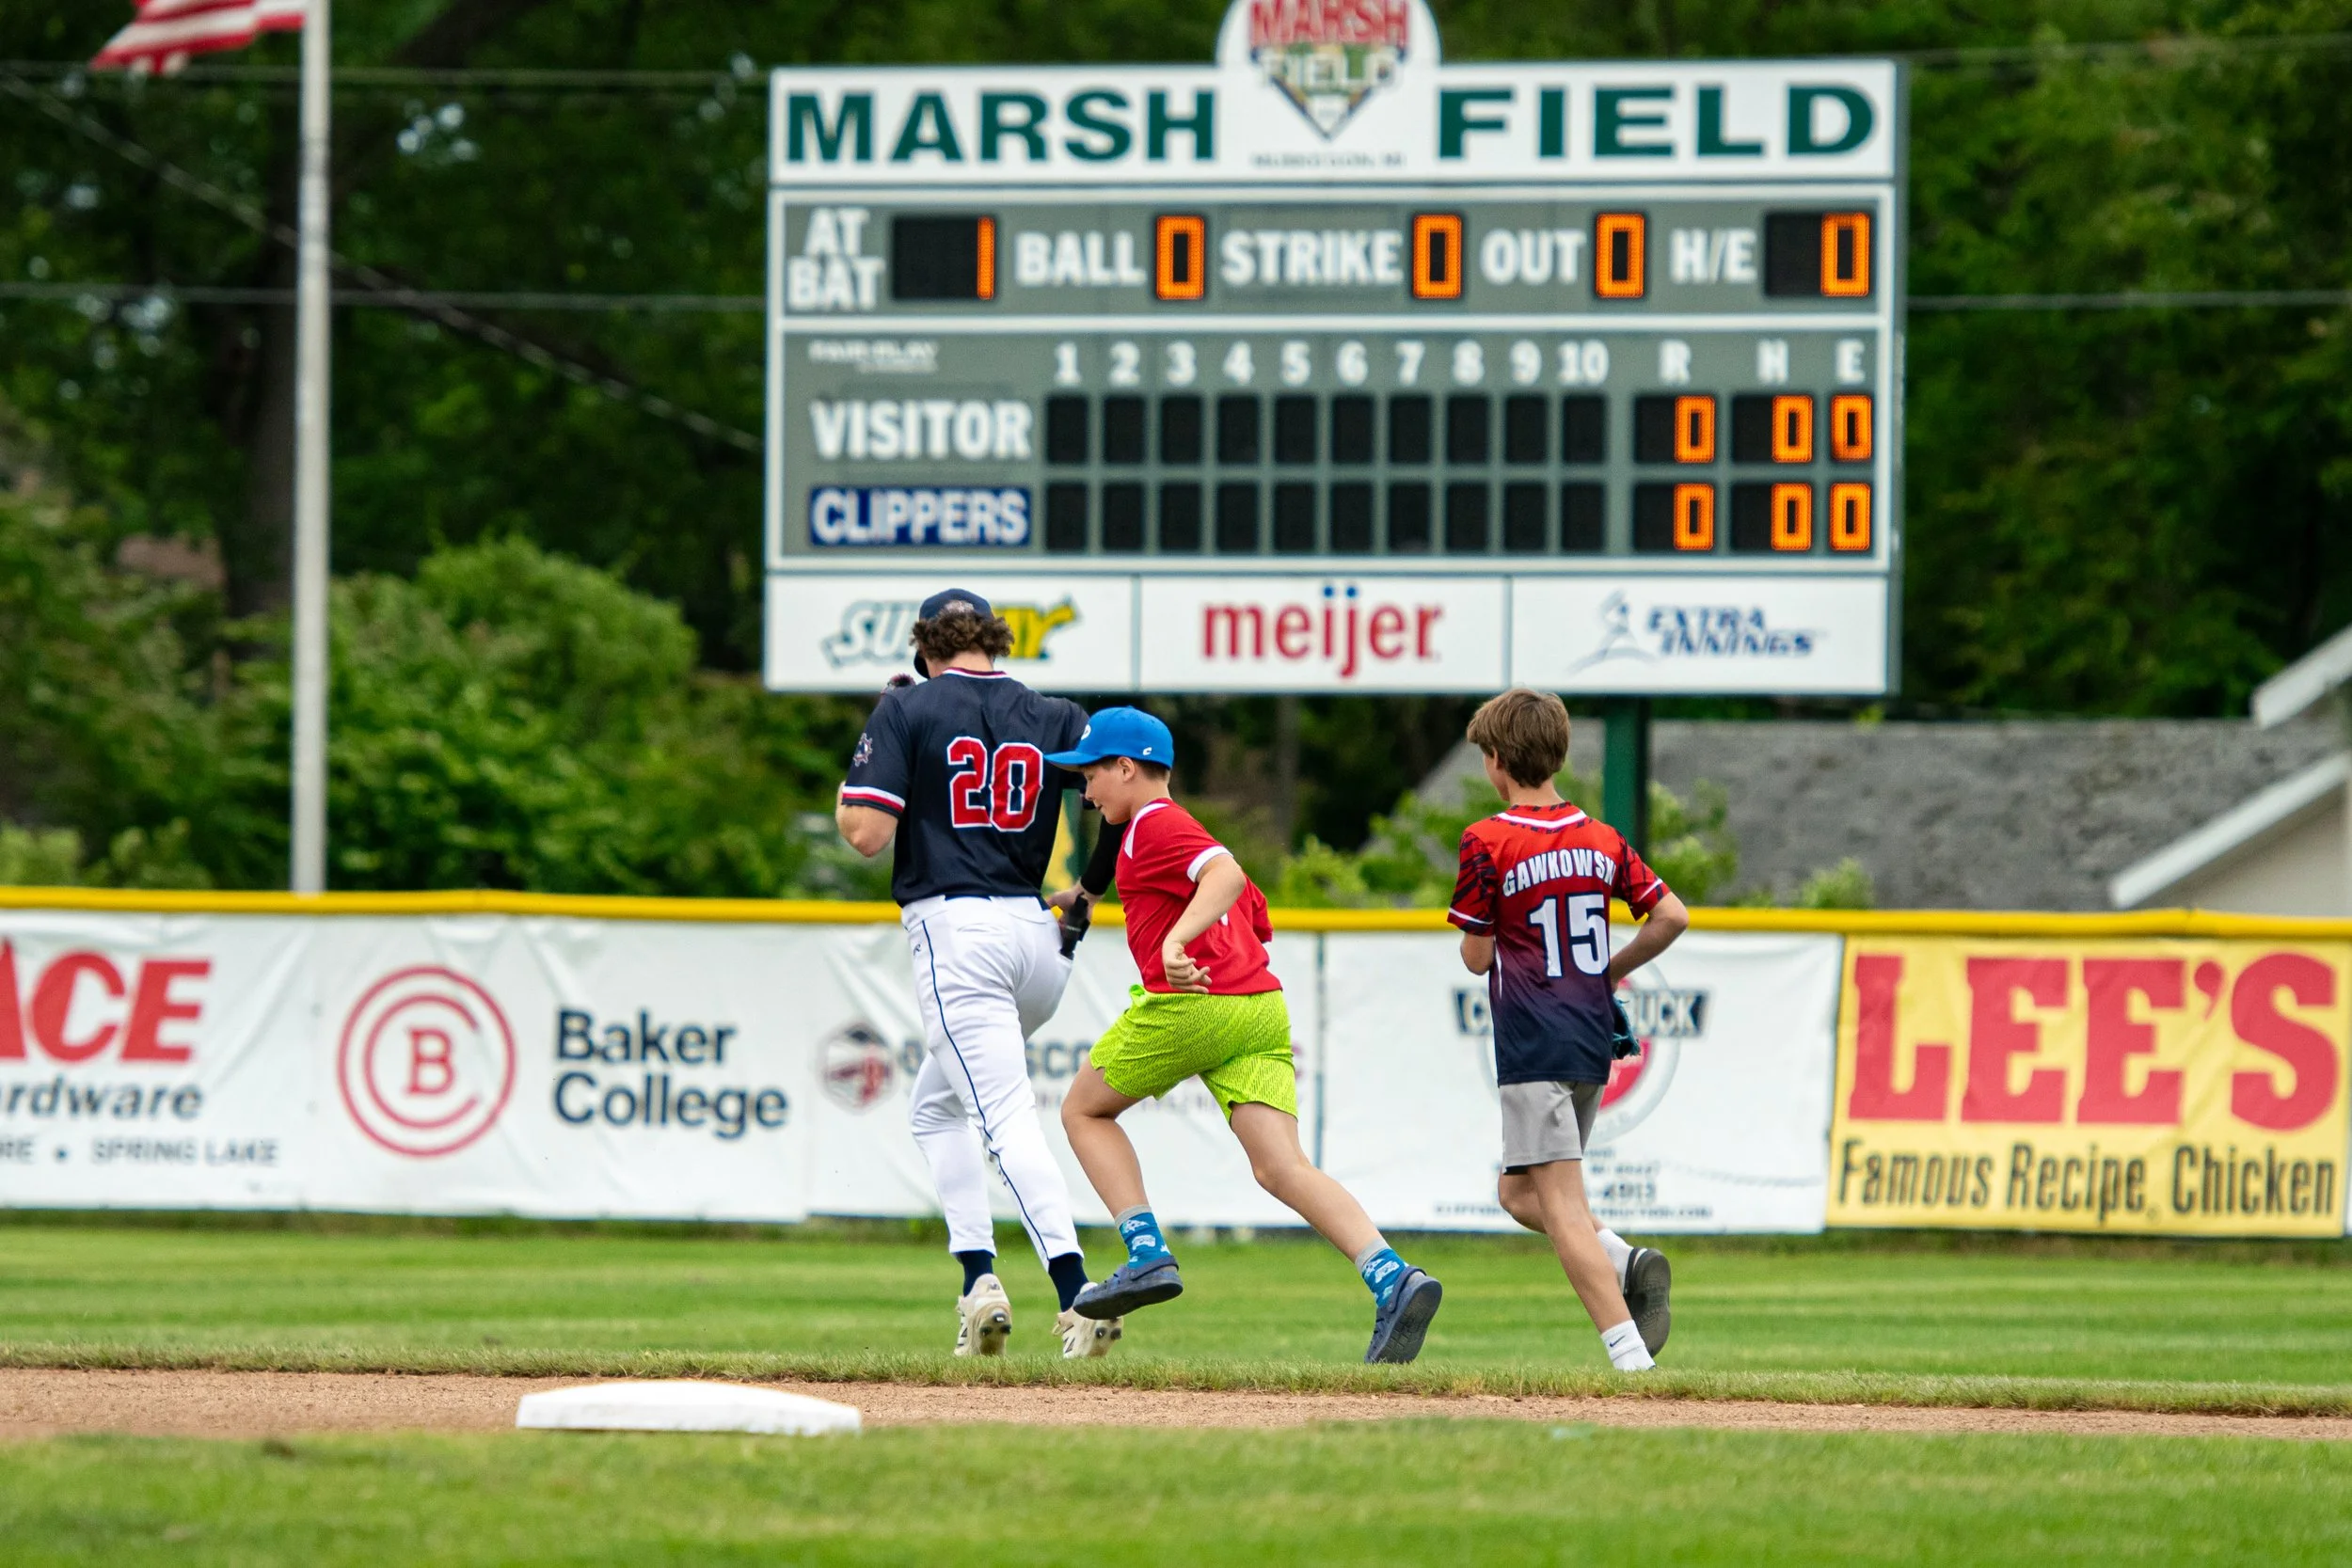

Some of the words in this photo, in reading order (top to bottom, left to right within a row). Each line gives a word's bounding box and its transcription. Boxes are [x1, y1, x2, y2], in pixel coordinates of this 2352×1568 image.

[787, 90, 1216, 162] MARSH
[1438, 85, 1875, 158] FIELD
[804, 208, 869, 256] AT
[1015, 231, 1146, 286] BALL
[1156, 215, 1205, 300] 0
[1220, 229, 1403, 286] STRIKE
[1413, 214, 1462, 299] 0
[1481, 229, 1585, 284] OUT
[1596, 214, 1645, 298] 0
[1670, 229, 1757, 284] H/E
[1820, 213, 1870, 297] 0
[788, 257, 884, 309] BAT
[1055, 341, 1081, 384] 1
[1110, 341, 1140, 384] 2
[1167, 341, 1197, 384] 3
[1223, 341, 1255, 384] 4
[1280, 341, 1311, 384] 5
[1337, 341, 1368, 384] 6
[1395, 341, 1425, 384] 7
[1454, 341, 1485, 384] 8
[1511, 341, 1542, 384] 9
[1558, 341, 1610, 384] 10
[1659, 340, 1691, 382] R
[1757, 340, 1788, 382] H
[1836, 340, 1865, 382] E
[810, 400, 1033, 460] VISITOR
[1674, 395, 1716, 464] 0
[1772, 395, 1814, 464] 0
[1830, 395, 1872, 461] 0
[811, 490, 1030, 544] CLIPPERS
[1673, 483, 1715, 551] 0
[1771, 483, 1813, 551] 0
[1829, 483, 1871, 551] 0
[1202, 585, 1444, 678] meijer
[1647, 605, 1765, 632] EXTRA
[1660, 630, 1813, 657] INNINGS
[946, 735, 1044, 832] 20
[1502, 848, 1617, 896] GAWKOWSK
[1527, 891, 1611, 977] 15
[553, 1008, 738, 1065] Baker
[1632, 990, 1700, 1036] UCK
[1848, 951, 2340, 1132] LEE'S
[405, 1027, 455, 1097] B
[0, 1075, 202, 1118] rdware
[552, 1070, 789, 1139] College
[91, 1137, 197, 1164] SPRING
[204, 1138, 279, 1166] LAKE
[1839, 1139, 1994, 1208] Famous
[2005, 1142, 2147, 1224] Recipe
[2172, 1144, 2335, 1217] Chicken
